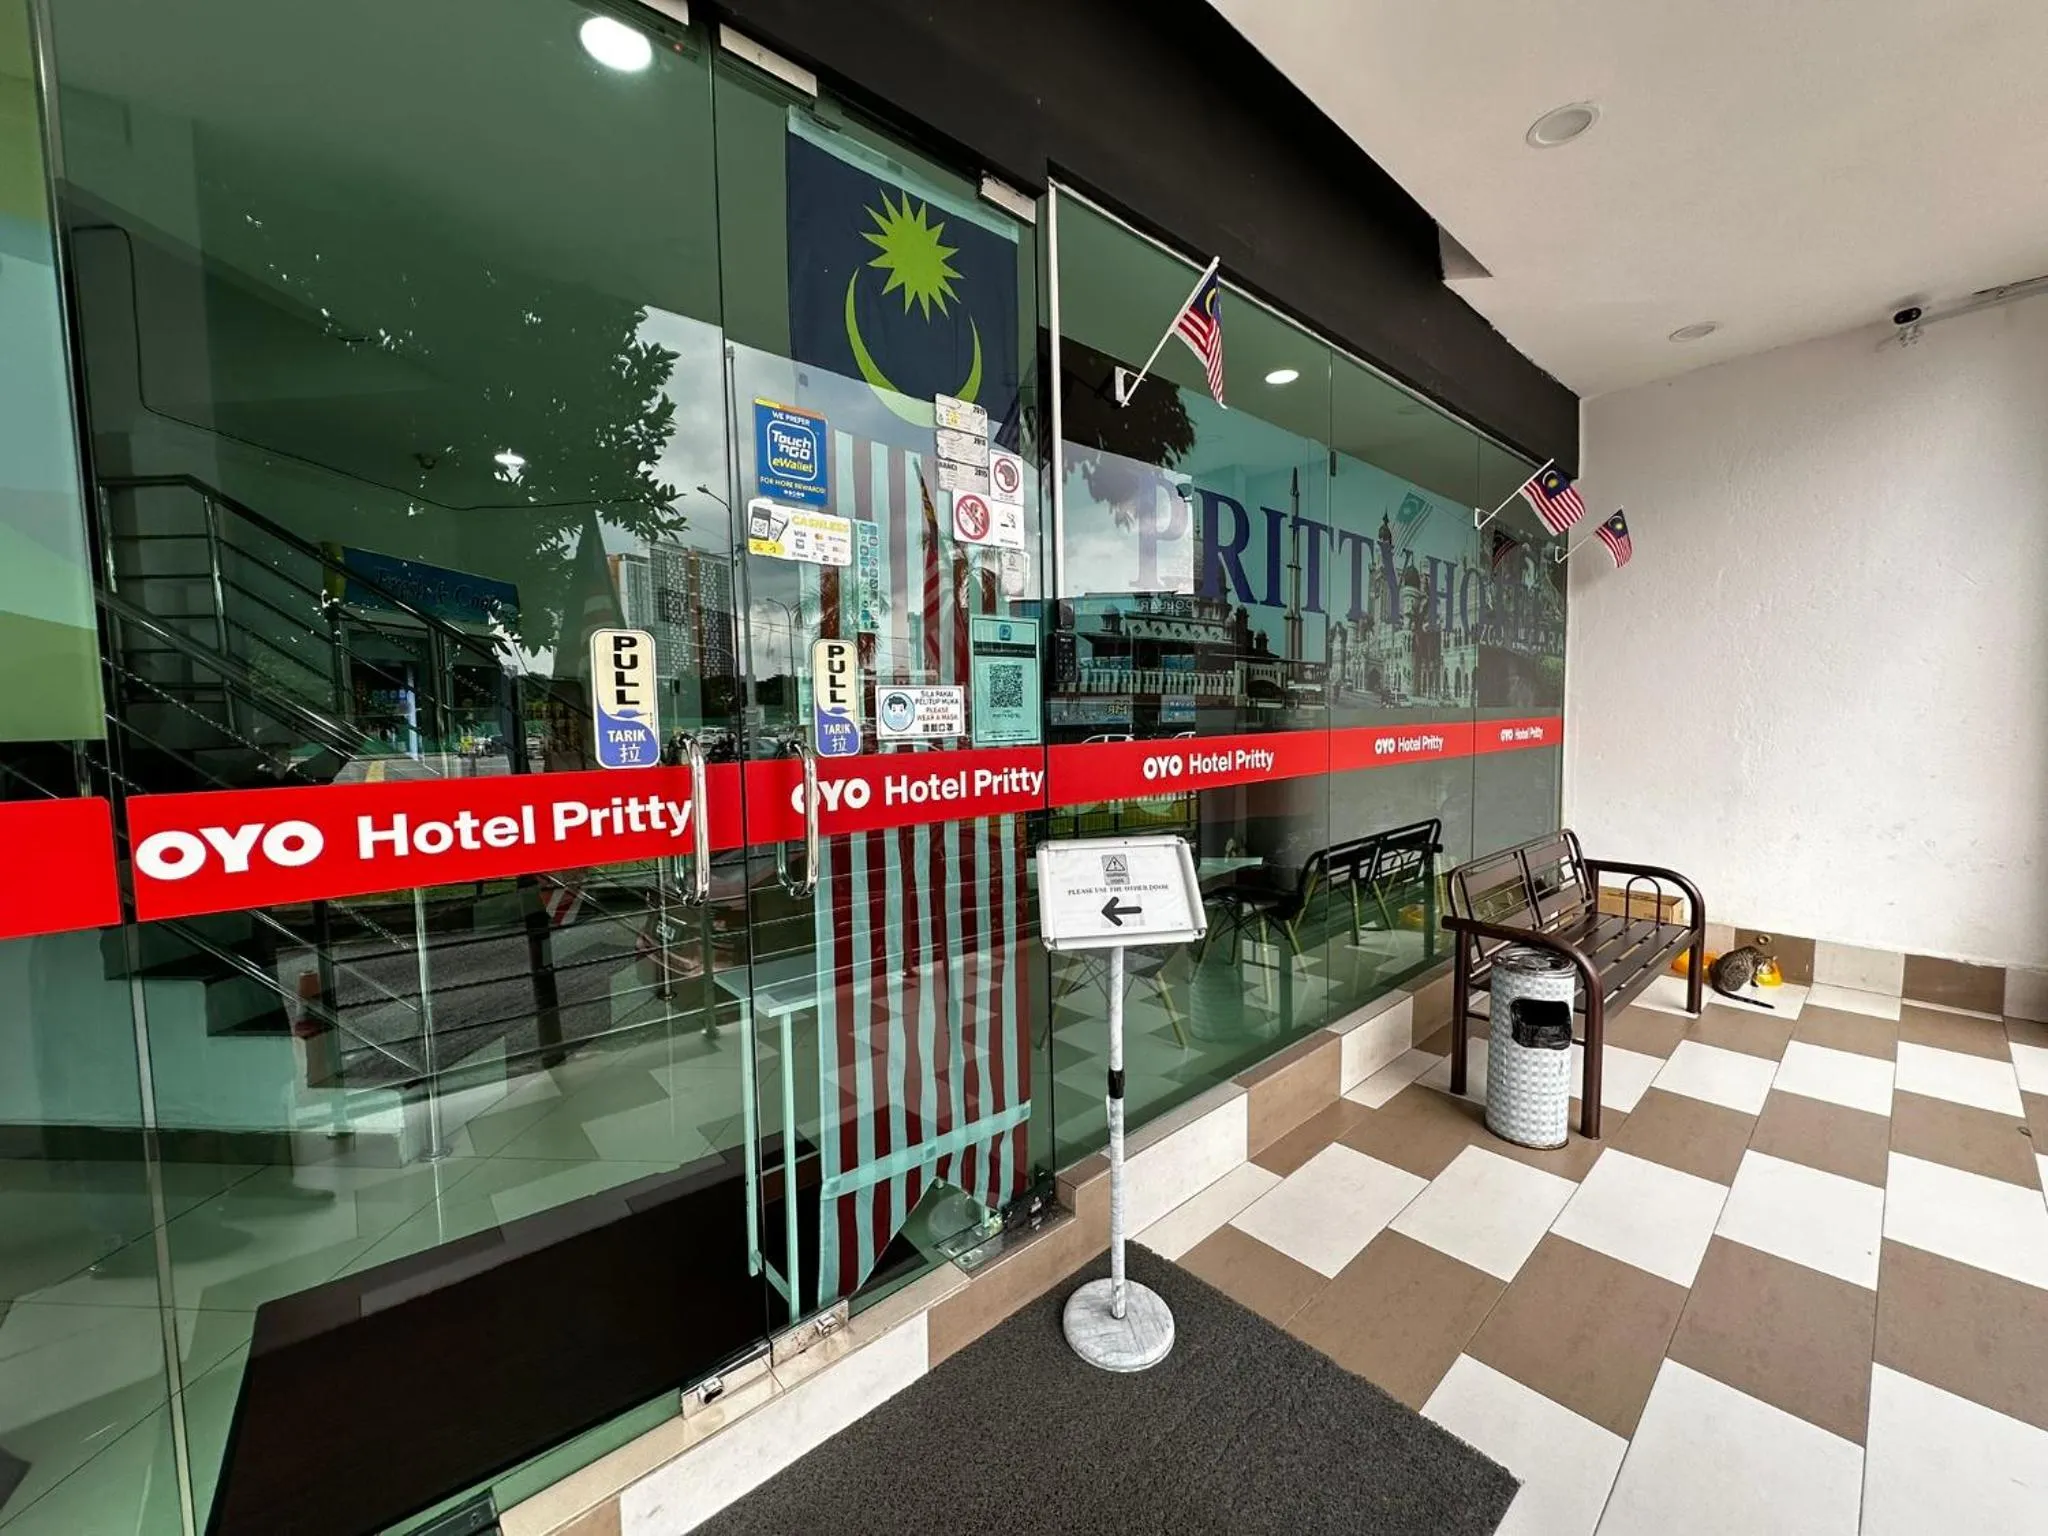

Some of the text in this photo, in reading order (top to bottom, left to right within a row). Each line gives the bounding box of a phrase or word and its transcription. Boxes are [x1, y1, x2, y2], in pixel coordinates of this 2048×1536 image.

[772, 410, 810, 426] WE PREFER
[771, 429, 811, 450] Touch
[772, 457, 813, 474] eWallet
[760, 476, 774, 486] FOR
[1129, 470, 1411, 625] PRITTY
[613, 636, 640, 705] PULL
[828, 645, 847, 704] PULL
[607, 729, 646, 743] TARIK
[823, 723, 851, 735] TARIK
[1500, 727, 1514, 742] OYO
[619, 743, 640, 763] 拉
[832, 736, 847, 752] 拉
[1375, 734, 1444, 754] OYO Hotel Pritty
[1143, 749, 1275, 780] OYO Hotel Pritty
[884, 771, 967, 806] Hotel
[973, 766, 1044, 797] Pritty
[135, 794, 693, 881] OYO Hotel Pritty
[1067, 888, 1093, 896] PLEASE
